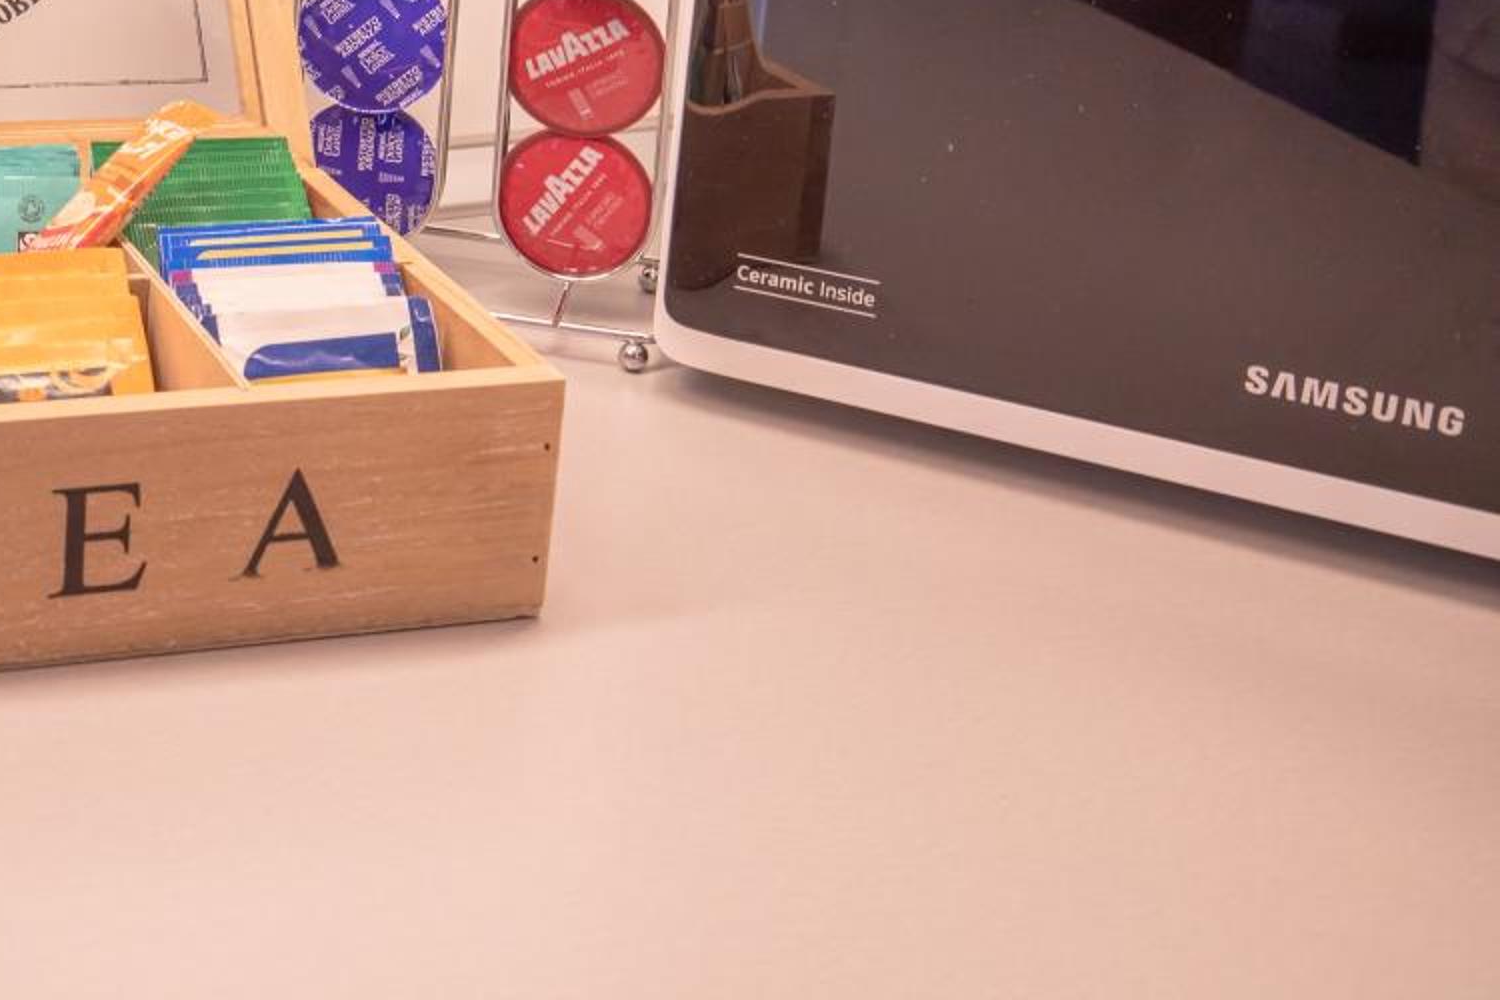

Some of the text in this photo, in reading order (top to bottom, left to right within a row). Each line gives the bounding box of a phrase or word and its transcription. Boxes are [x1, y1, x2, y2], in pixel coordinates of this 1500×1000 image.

[525, 18, 630, 81] LAVAZZA
[522, 145, 605, 236] LAVAZZA
[736, 264, 876, 307] Ceramic Inside
[1244, 364, 1466, 438] SAMSUNG
